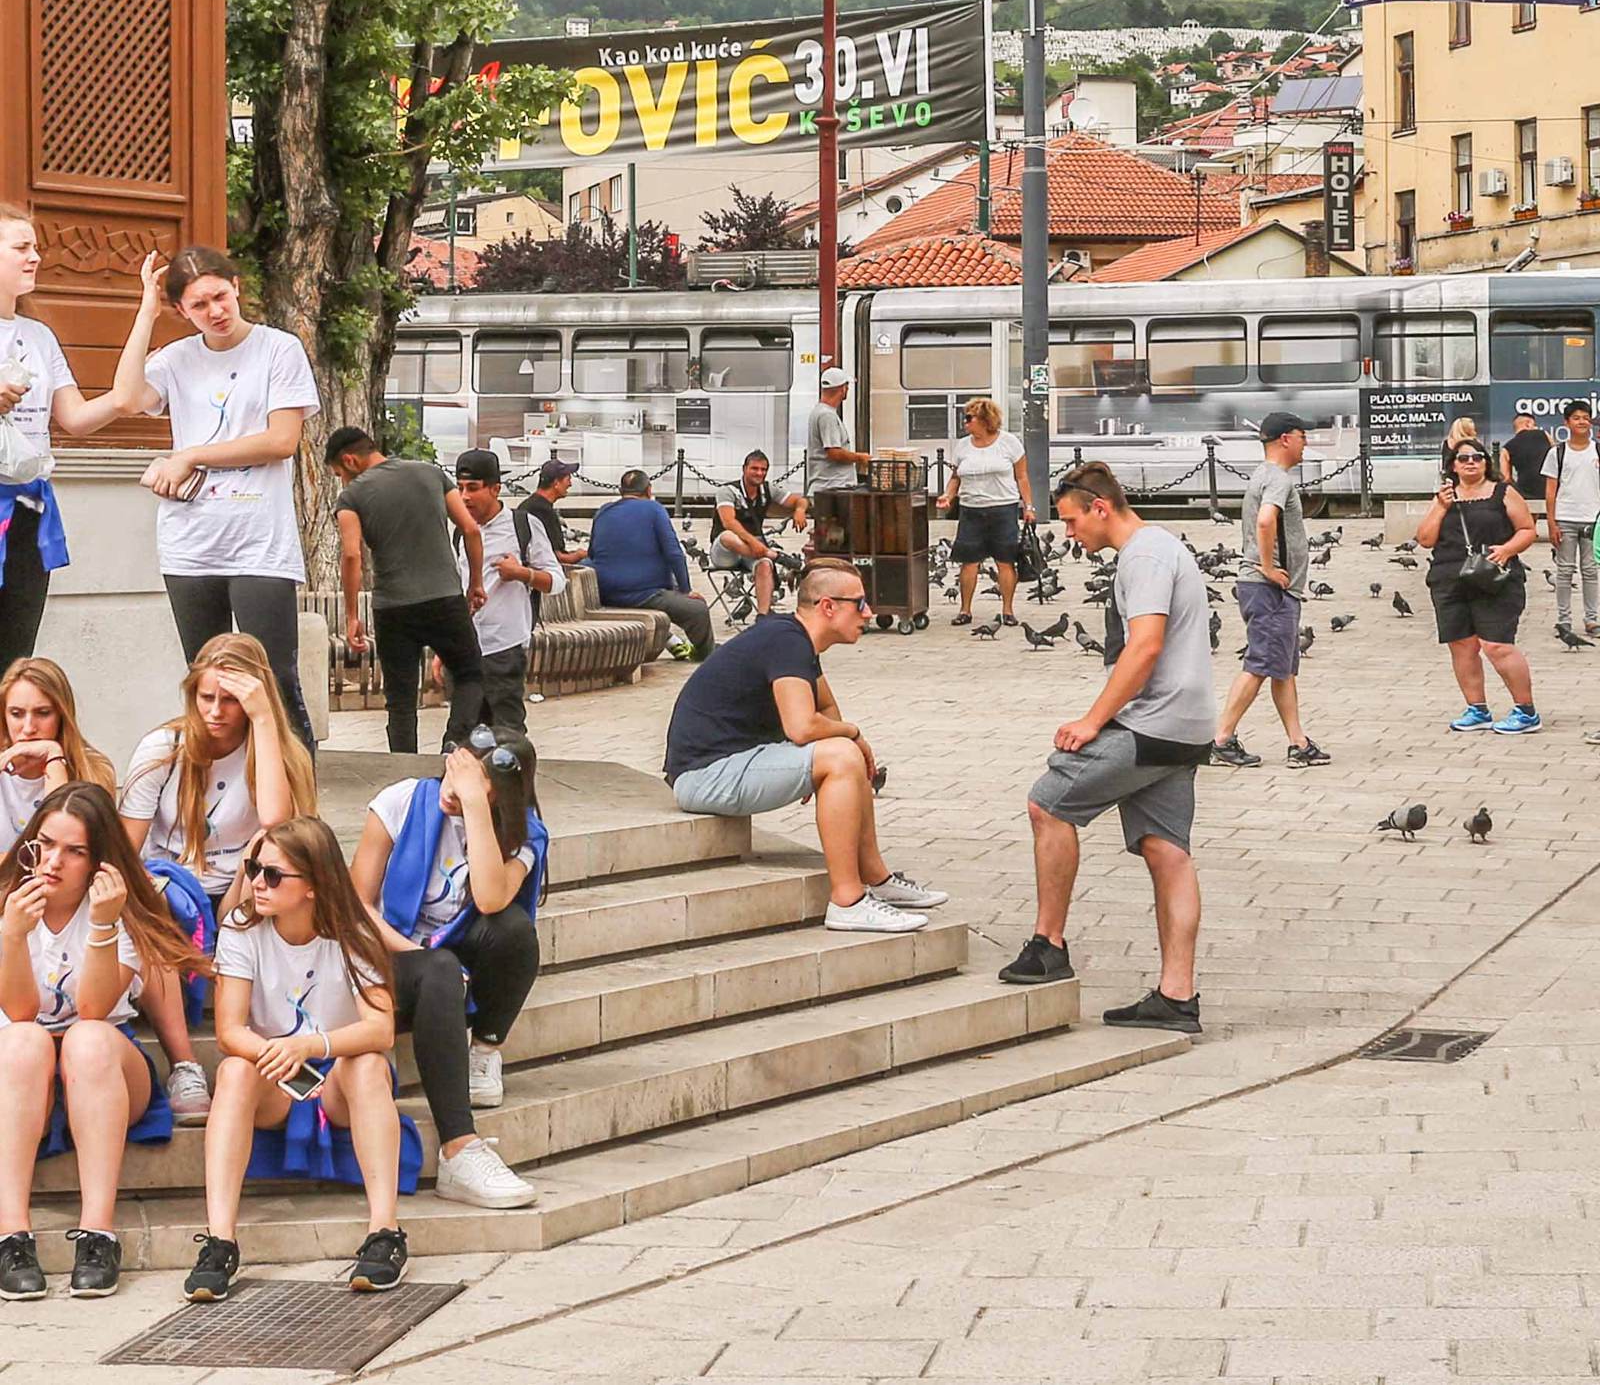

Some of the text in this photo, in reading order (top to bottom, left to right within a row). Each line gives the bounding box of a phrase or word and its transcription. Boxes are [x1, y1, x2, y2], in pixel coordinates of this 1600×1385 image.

[599, 37, 742, 67] Kao kod kuće
[794, 27, 930, 104] 30.VI
[799, 99, 932, 135] KŠEVO
[1330, 156, 1350, 244] HOTEL
[1370, 393, 1473, 404] PLATO SKENDERIJA
[1370, 412, 1446, 423] DOLAC MALTA
[1370, 432, 1412, 445] BLAŽUJ
